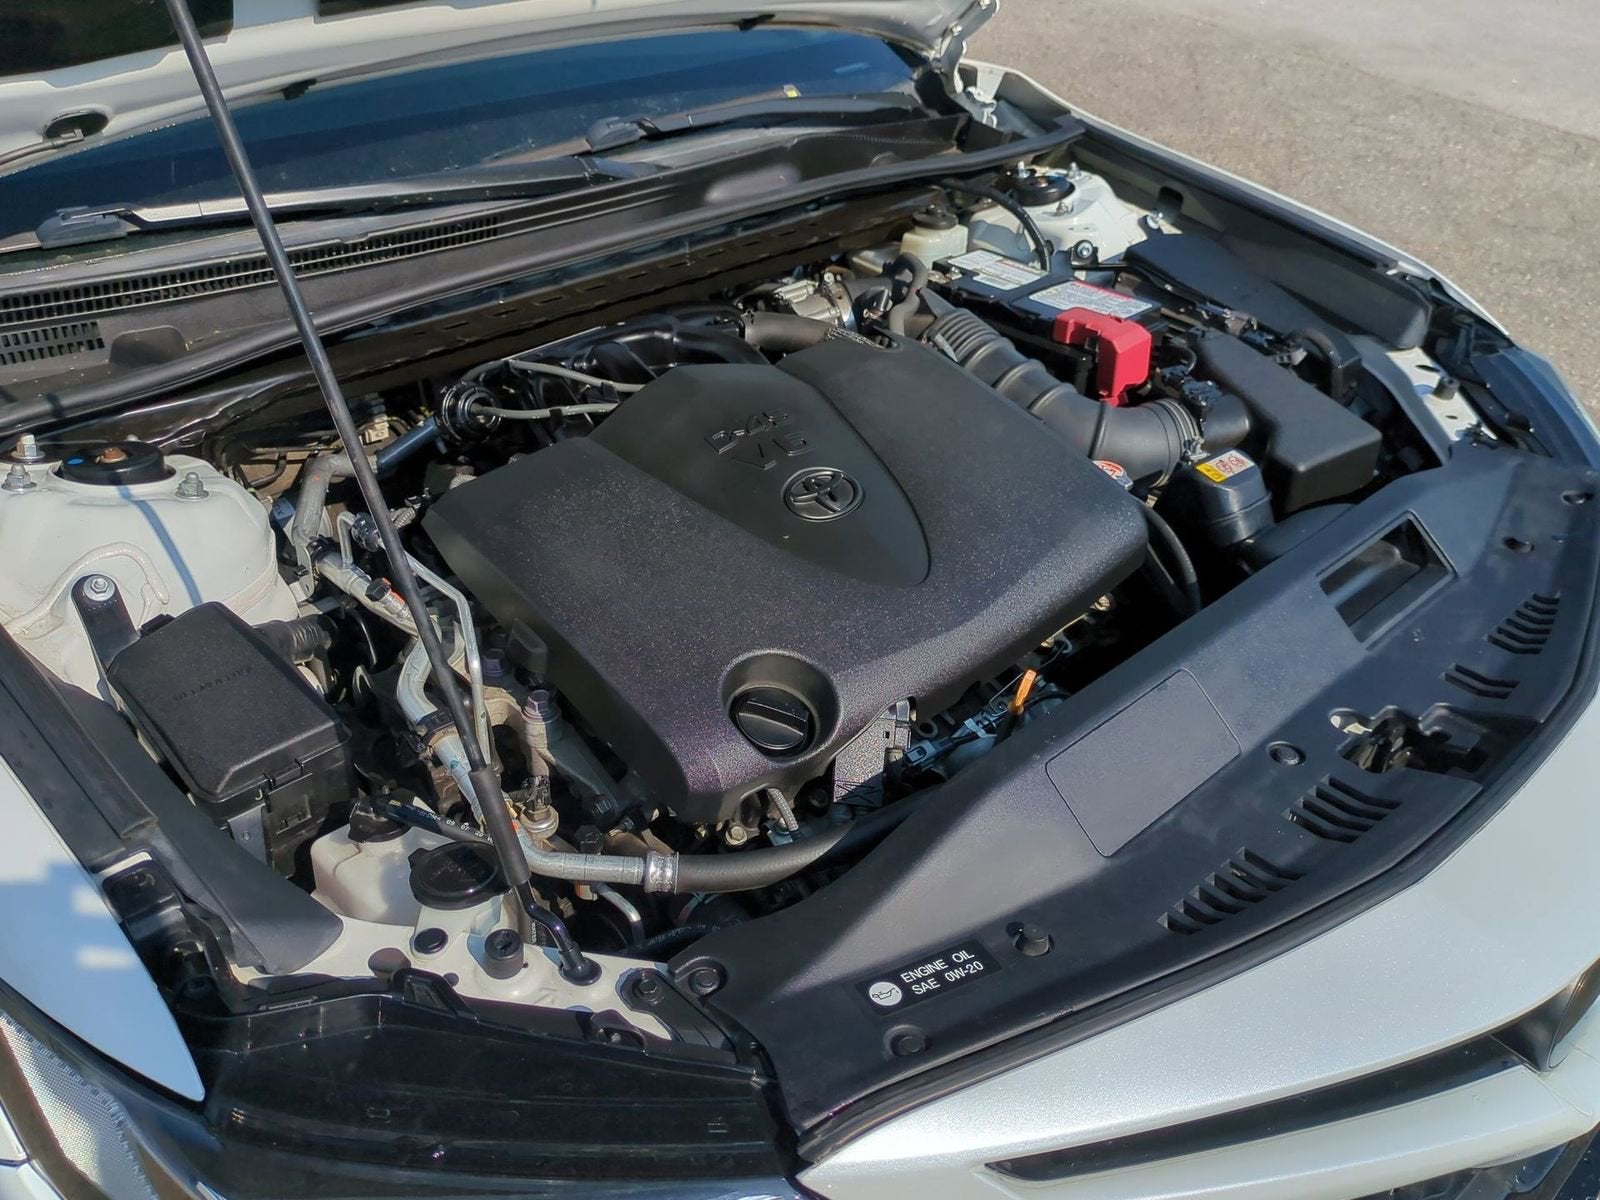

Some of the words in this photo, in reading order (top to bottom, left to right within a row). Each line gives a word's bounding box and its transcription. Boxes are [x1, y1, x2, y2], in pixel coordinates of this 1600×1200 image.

[900, 958, 949, 983] ENGINE
[951, 950, 976, 964] OIL
[911, 978, 941, 995] SAE
[944, 960, 984, 982] 0W-20
